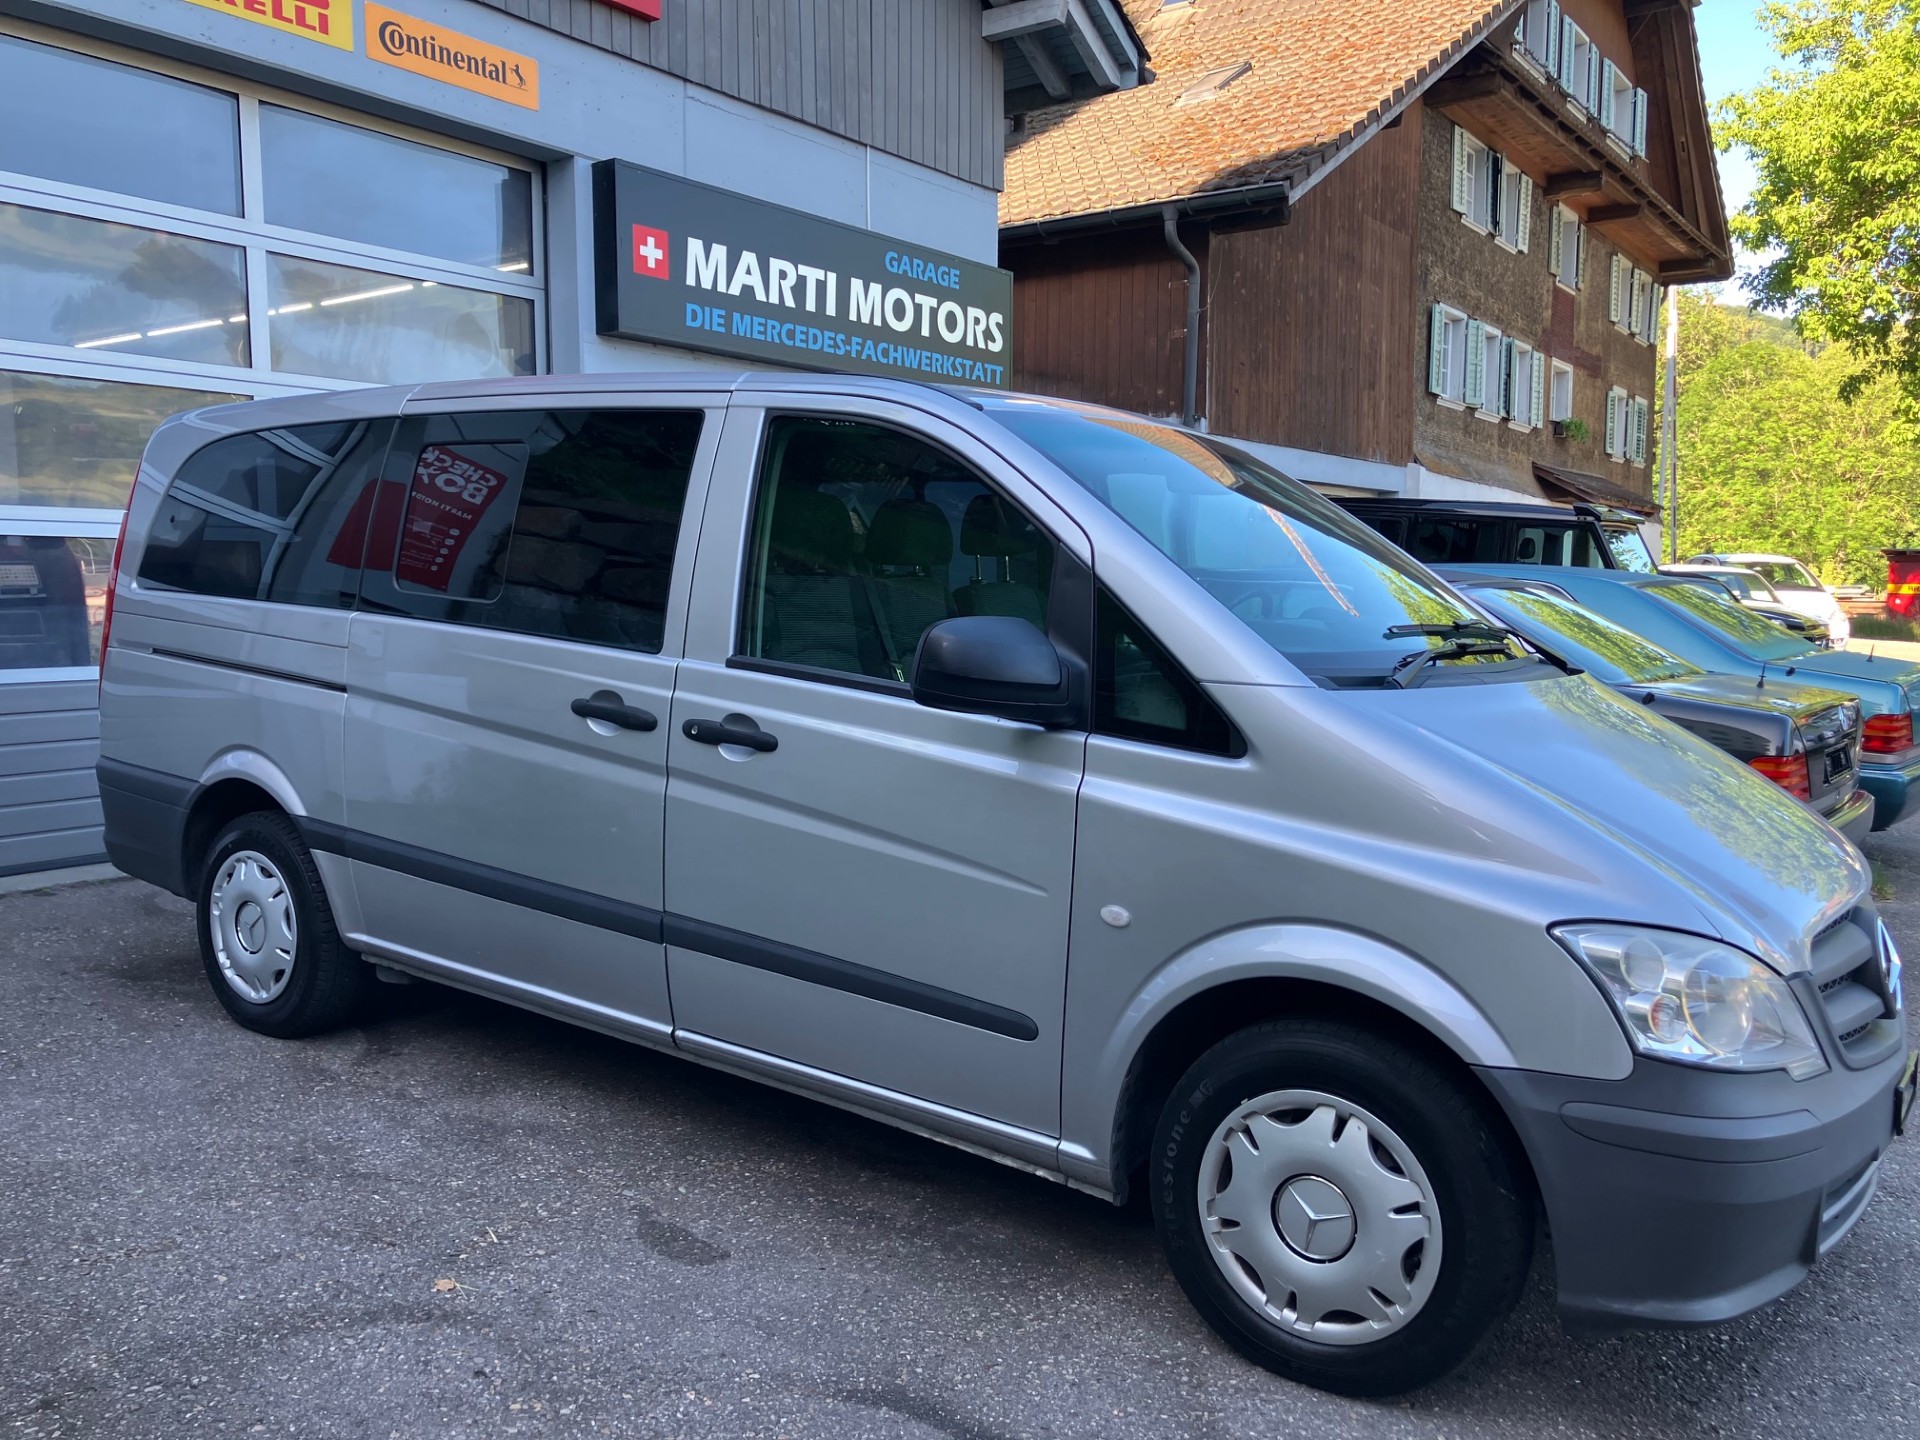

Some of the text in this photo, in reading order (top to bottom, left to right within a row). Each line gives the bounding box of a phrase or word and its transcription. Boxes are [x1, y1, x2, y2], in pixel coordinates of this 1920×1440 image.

[378, 20, 508, 85] Continental
[685, 236, 1004, 353] MARTI MOTORS
[884, 250, 960, 290] GARAGE
[685, 302, 1004, 385] DIE MERCEDES-FACHWERKSTATT
